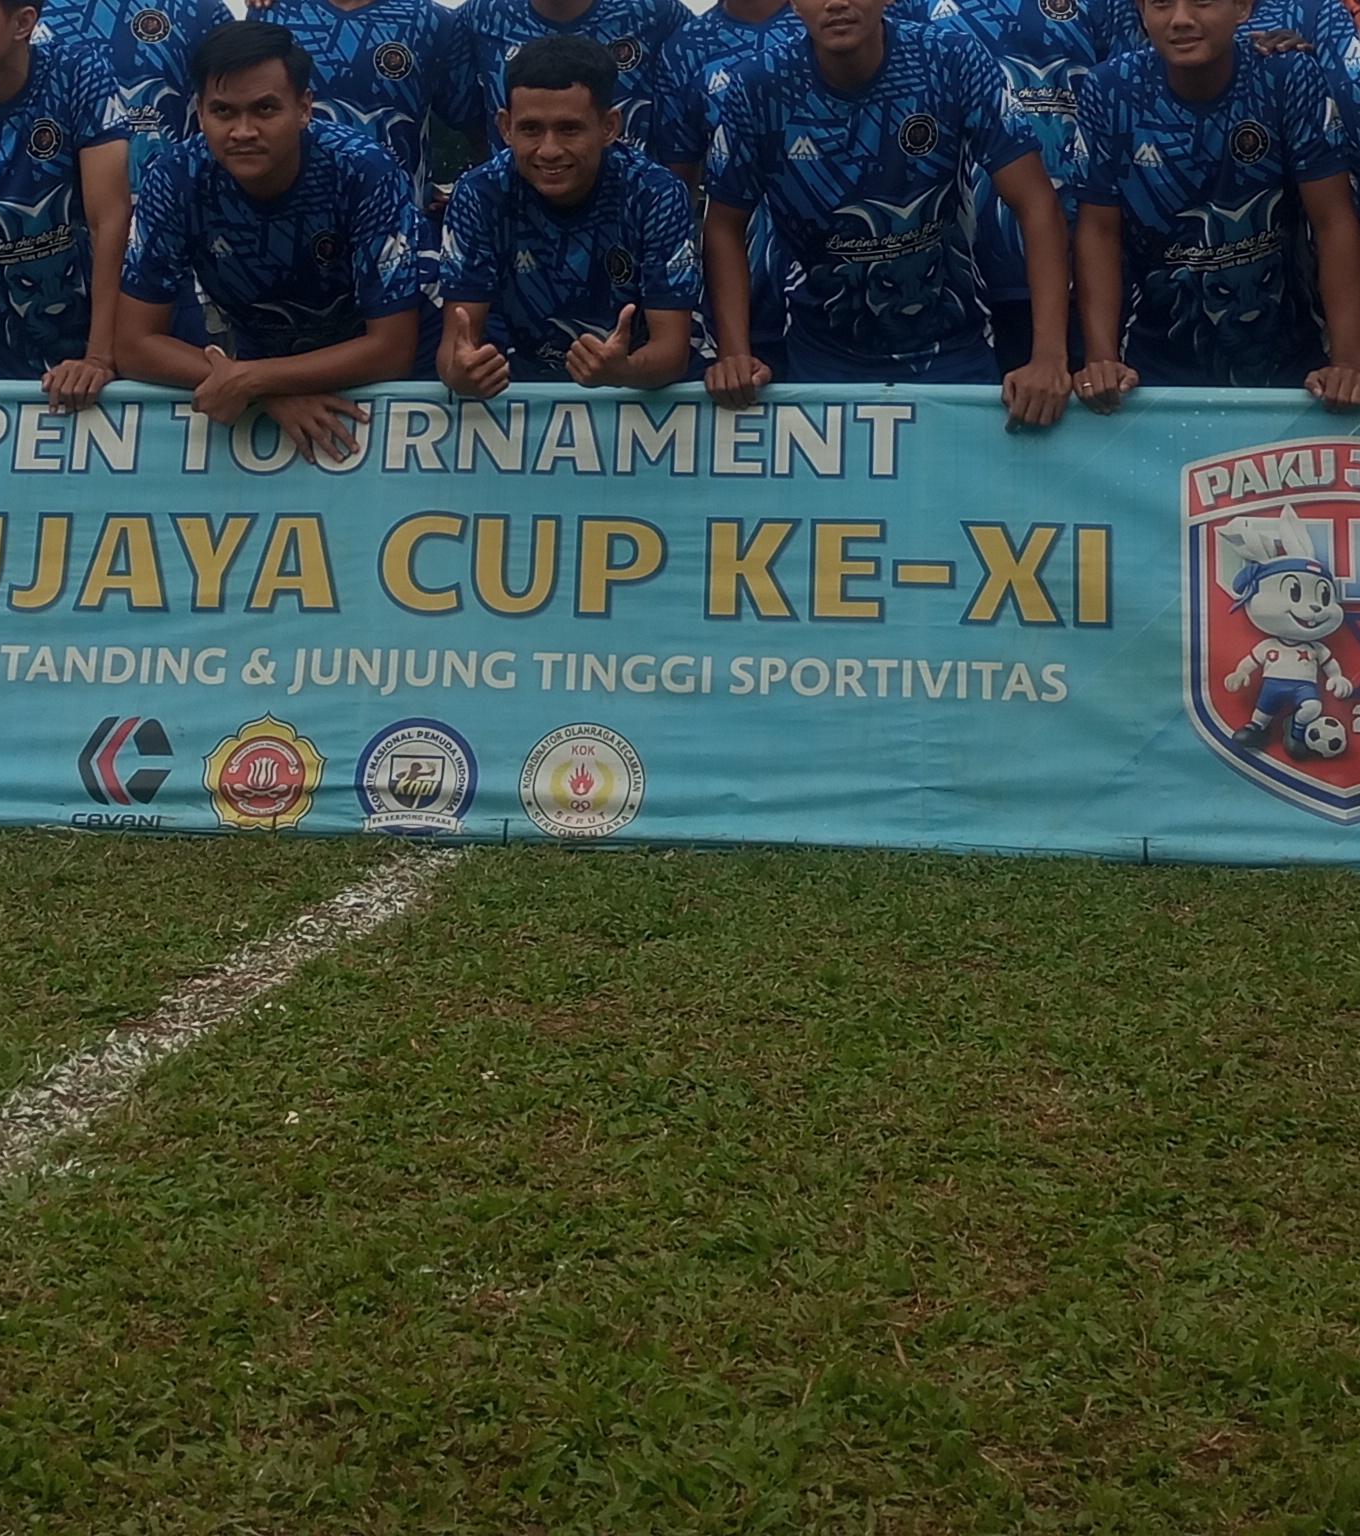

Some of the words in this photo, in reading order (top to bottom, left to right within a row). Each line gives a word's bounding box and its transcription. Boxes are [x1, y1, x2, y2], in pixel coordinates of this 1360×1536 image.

[1133, 160, 1163, 168] MOST
[826, 234, 879, 250] Lantana
[171, 397, 916, 480] TOURNAMENT
[1194, 449, 1337, 507] PAKU
[377, 510, 668, 620] CUP
[704, 517, 1115, 629] KE-XI
[240, 648, 276, 686] &
[286, 647, 517, 695] JUNJUNG
[533, 651, 714, 695] TINGGI
[729, 656, 1069, 703] SPORTIVITAS
[369, 731, 414, 771] NASIONAL
[416, 730, 458, 757] PEMUDA
[523, 732, 564, 789] KOORDINATOR
[564, 726, 616, 745] OLAHRAGA
[615, 740, 642, 793] KECAMATAN
[571, 745, 596, 756] KOK
[366, 772, 385, 811] KOMITE
[446, 756, 466, 812] INDONESIA
[70, 812, 162, 830] CAVANI
[385, 814, 423, 822] SERPONG
[425, 815, 452, 826] UTARA
[531, 810, 586, 839] SERPONG
[589, 814, 630, 837] UTARA
[555, 810, 607, 825] SERUT
